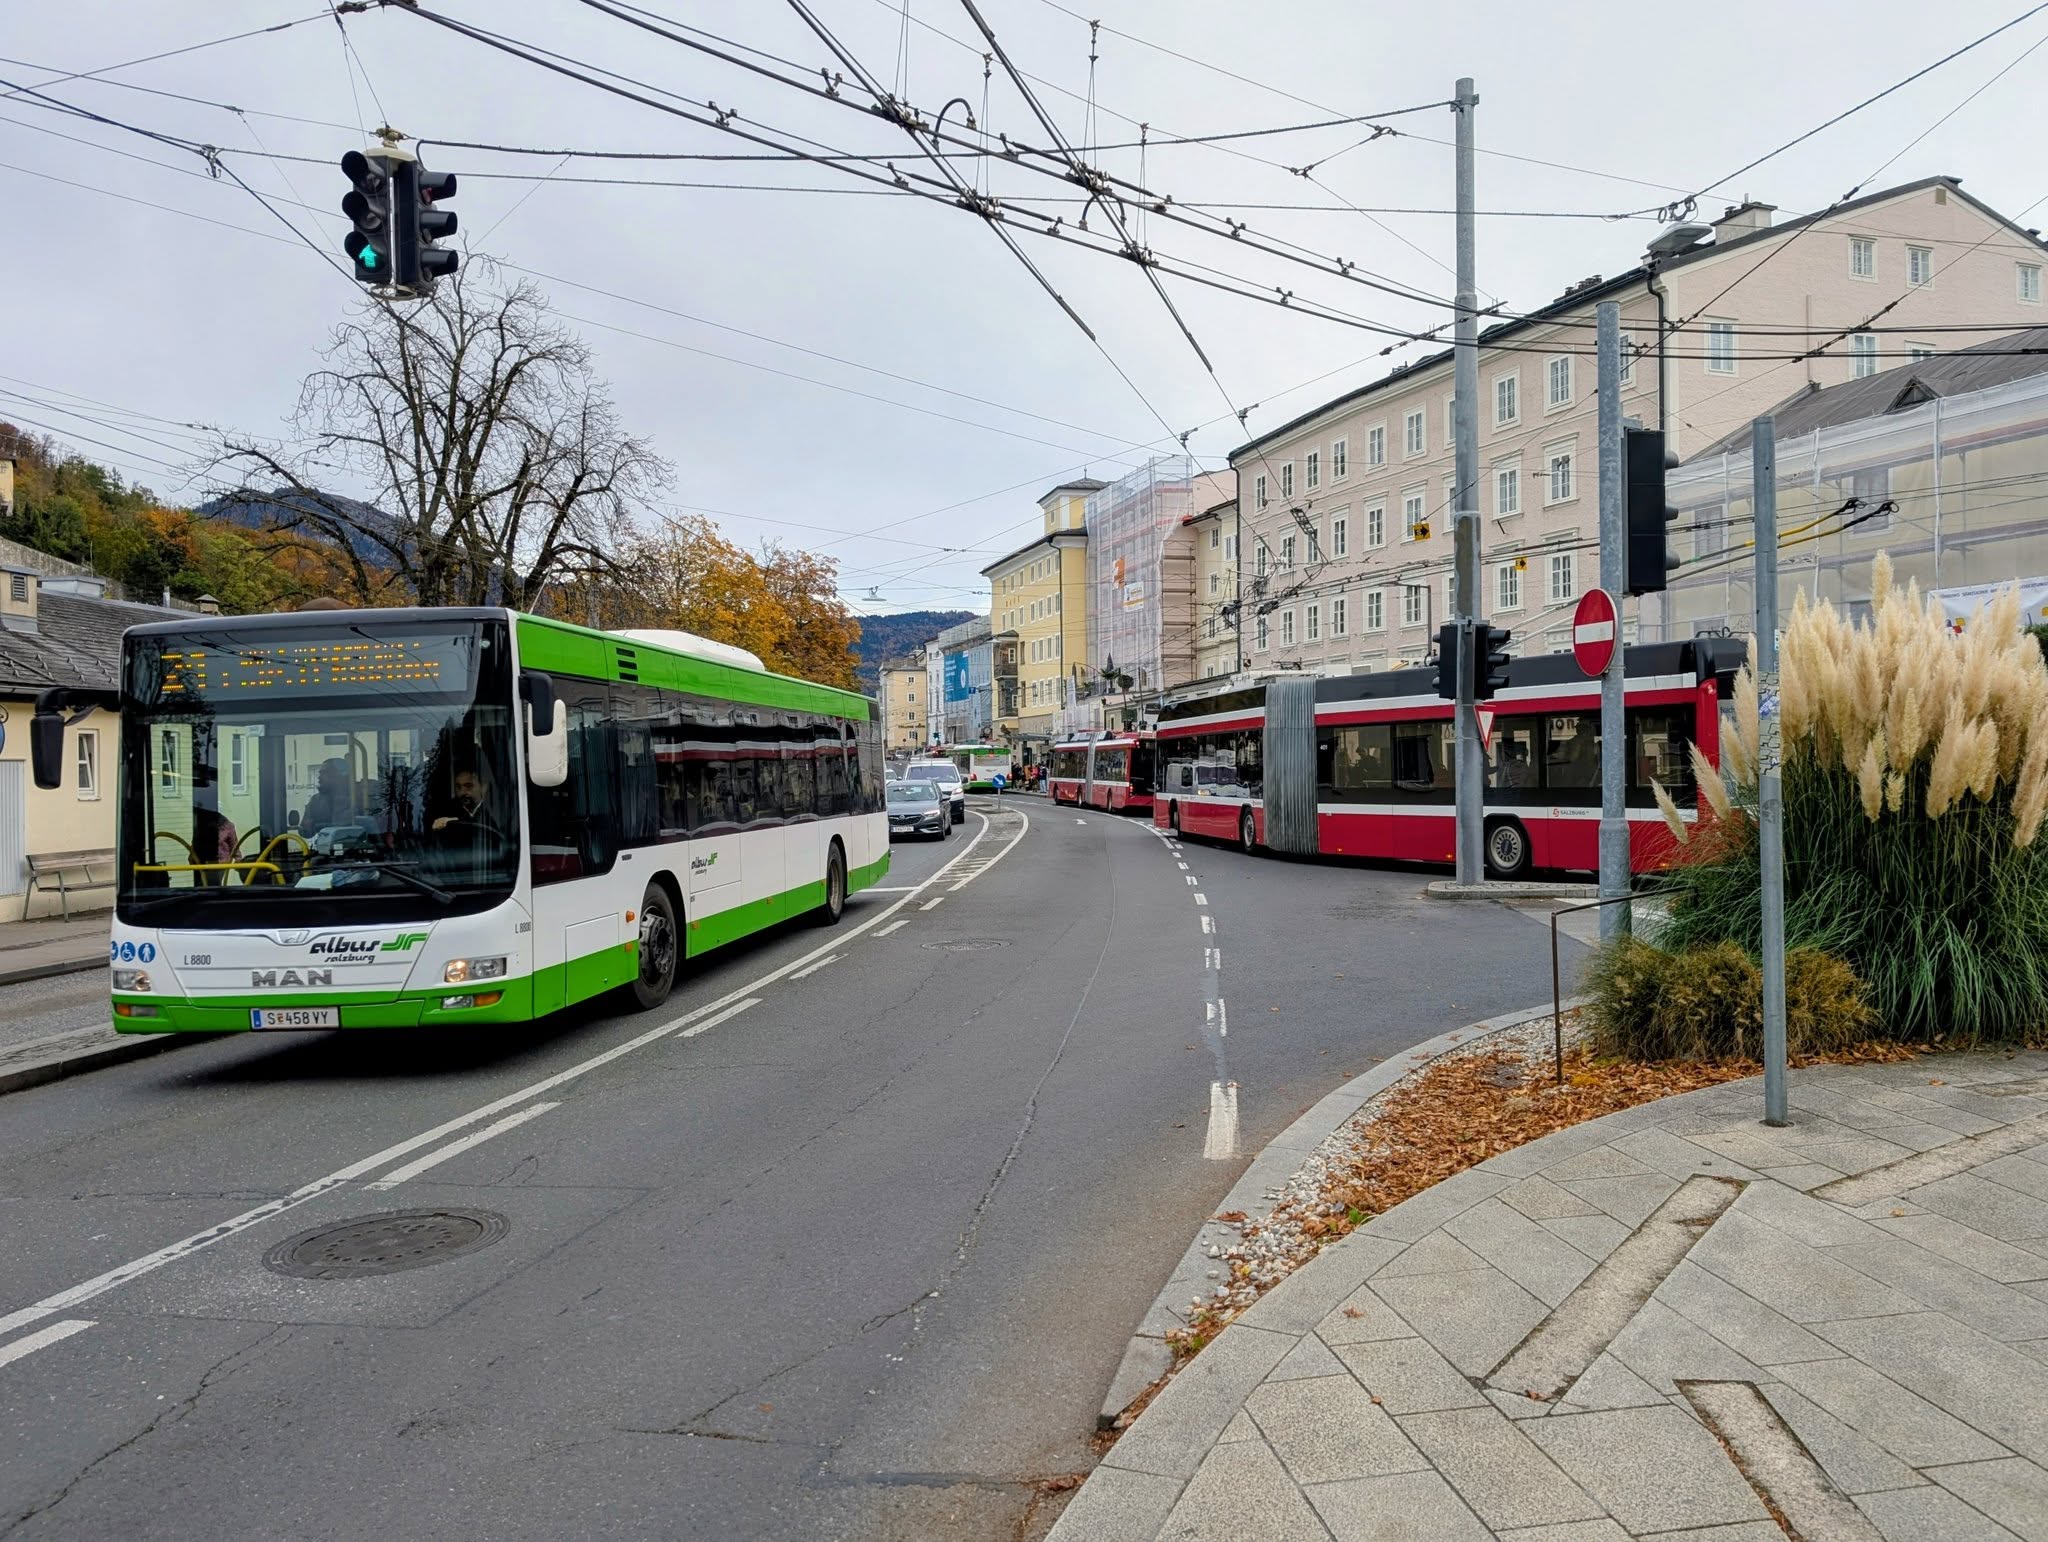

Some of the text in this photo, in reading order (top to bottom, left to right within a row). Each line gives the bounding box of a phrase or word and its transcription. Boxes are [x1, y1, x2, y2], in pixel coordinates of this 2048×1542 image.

[309, 937, 381, 954] albus
[184, 955, 212, 966] L 8800
[324, 954, 375, 964] salzburg
[252, 969, 333, 987] MAN
